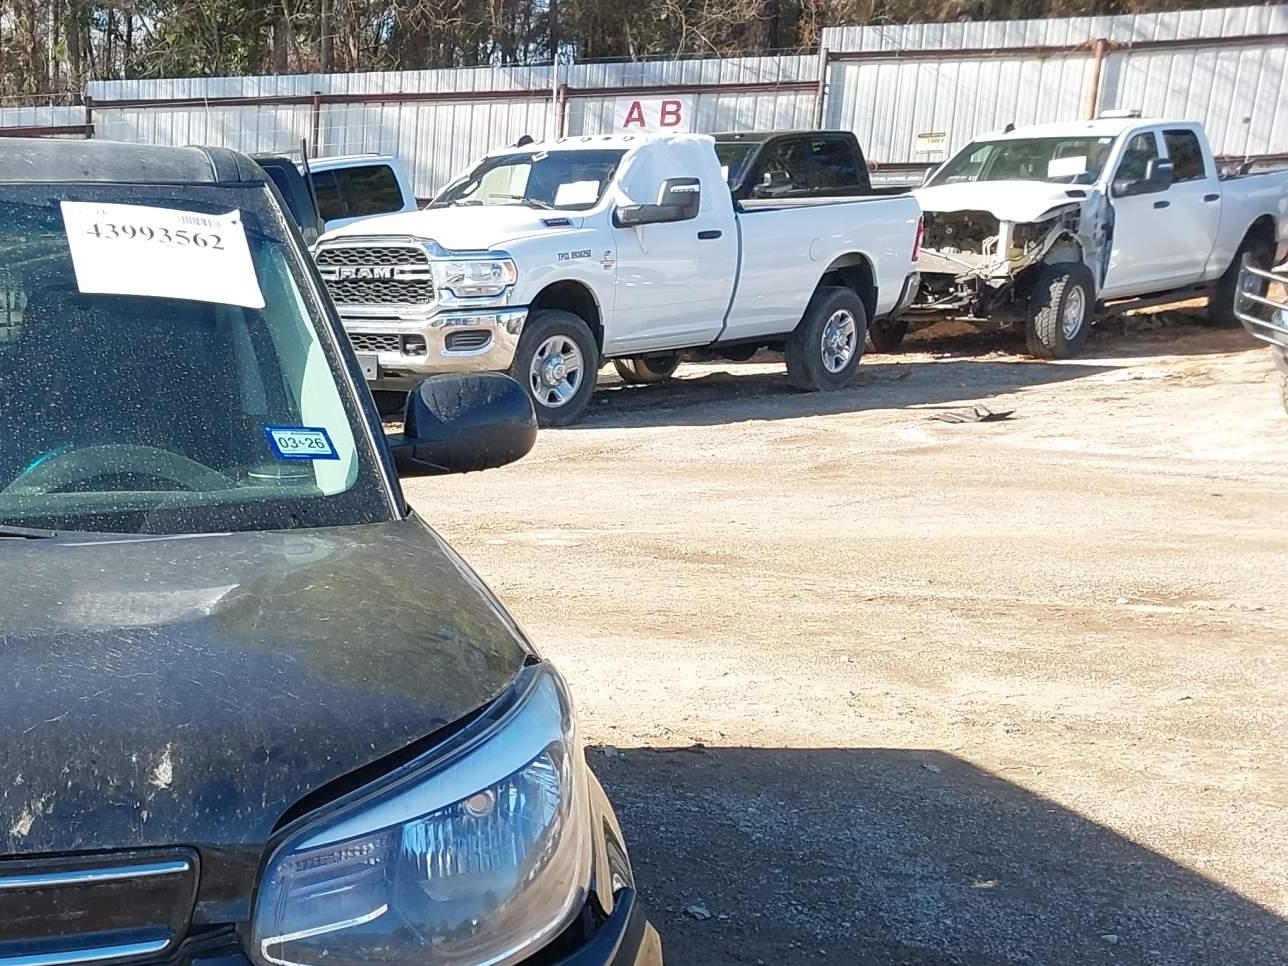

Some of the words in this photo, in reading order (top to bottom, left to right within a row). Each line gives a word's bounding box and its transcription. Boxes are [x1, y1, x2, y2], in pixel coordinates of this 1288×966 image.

[623, 100, 646, 128] A
[660, 100, 682, 127] B
[86, 223, 225, 251] 43993562
[340, 267, 391, 280] RAM
